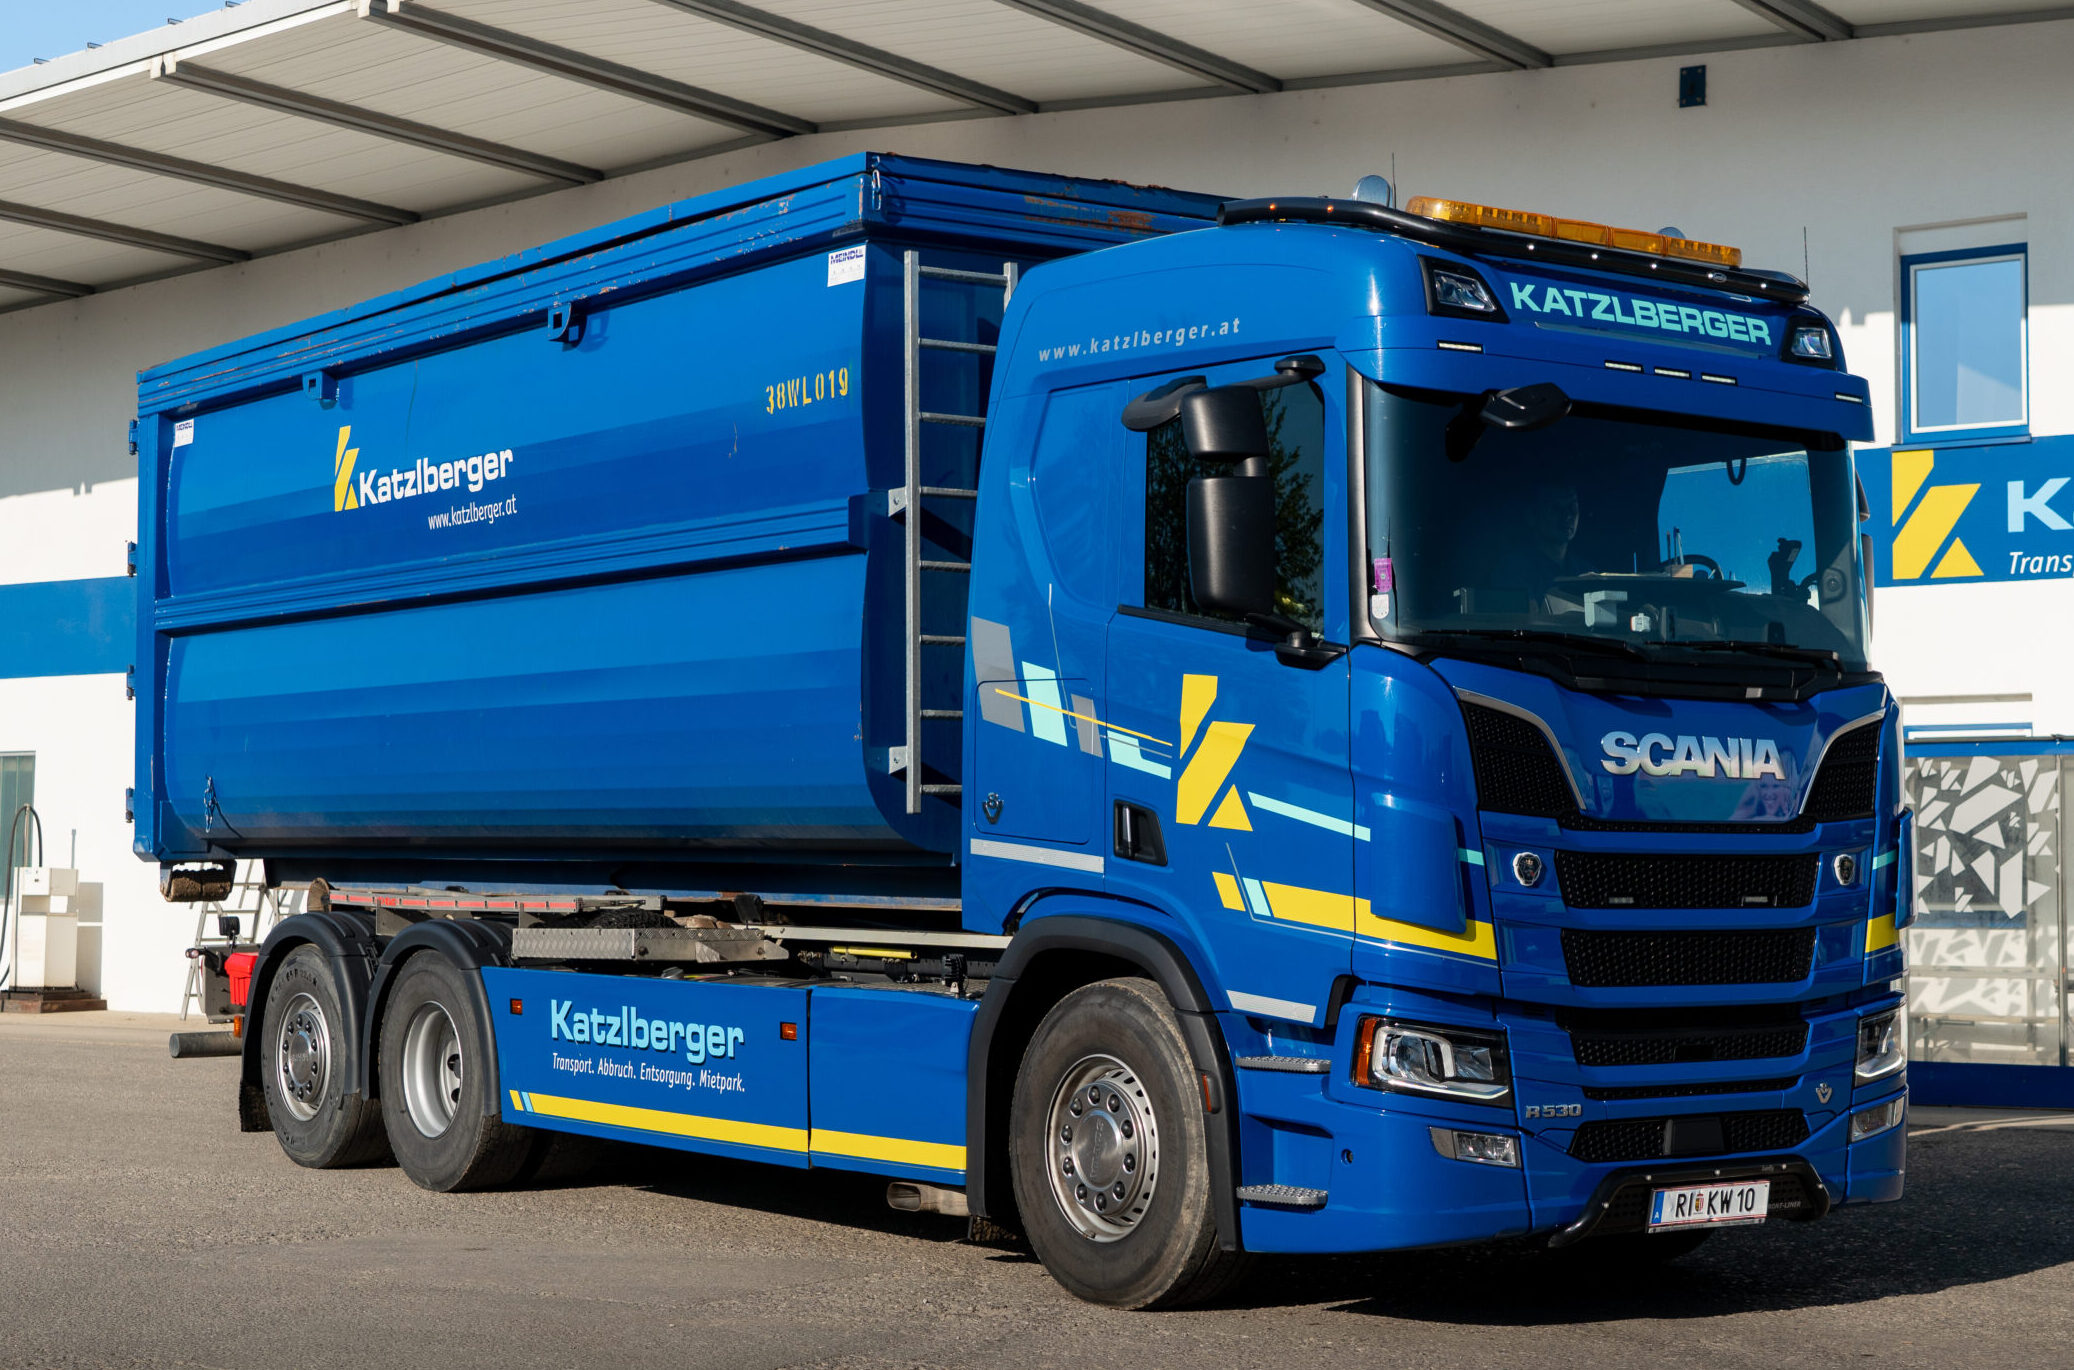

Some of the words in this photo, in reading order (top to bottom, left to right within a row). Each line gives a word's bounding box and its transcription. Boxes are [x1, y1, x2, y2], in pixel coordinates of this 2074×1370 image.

[1510, 282, 1772, 345] KATZLBERGER
[1039, 317, 1240, 362] www.katzlberger.at
[359, 448, 513, 507] Katzlberger
[427, 493, 517, 530] www.katzlberger.at
[2007, 477, 2074, 533] K
[2009, 551, 2074, 578] Trans
[1601, 731, 1786, 780] SCANIA
[551, 999, 745, 1064] Katzlberger
[553, 1052, 595, 1076] Transport.
[597, 1058, 636, 1079] Abbruch.
[640, 1062, 695, 1090] Entsorgung.
[699, 1069, 745, 1094] Mietpark.
[1542, 1103, 1582, 1118] 530
[1675, 1192, 1696, 1218] RI
[1707, 1188, 1734, 1215] KW
[1737, 1187, 1756, 1213] 10
